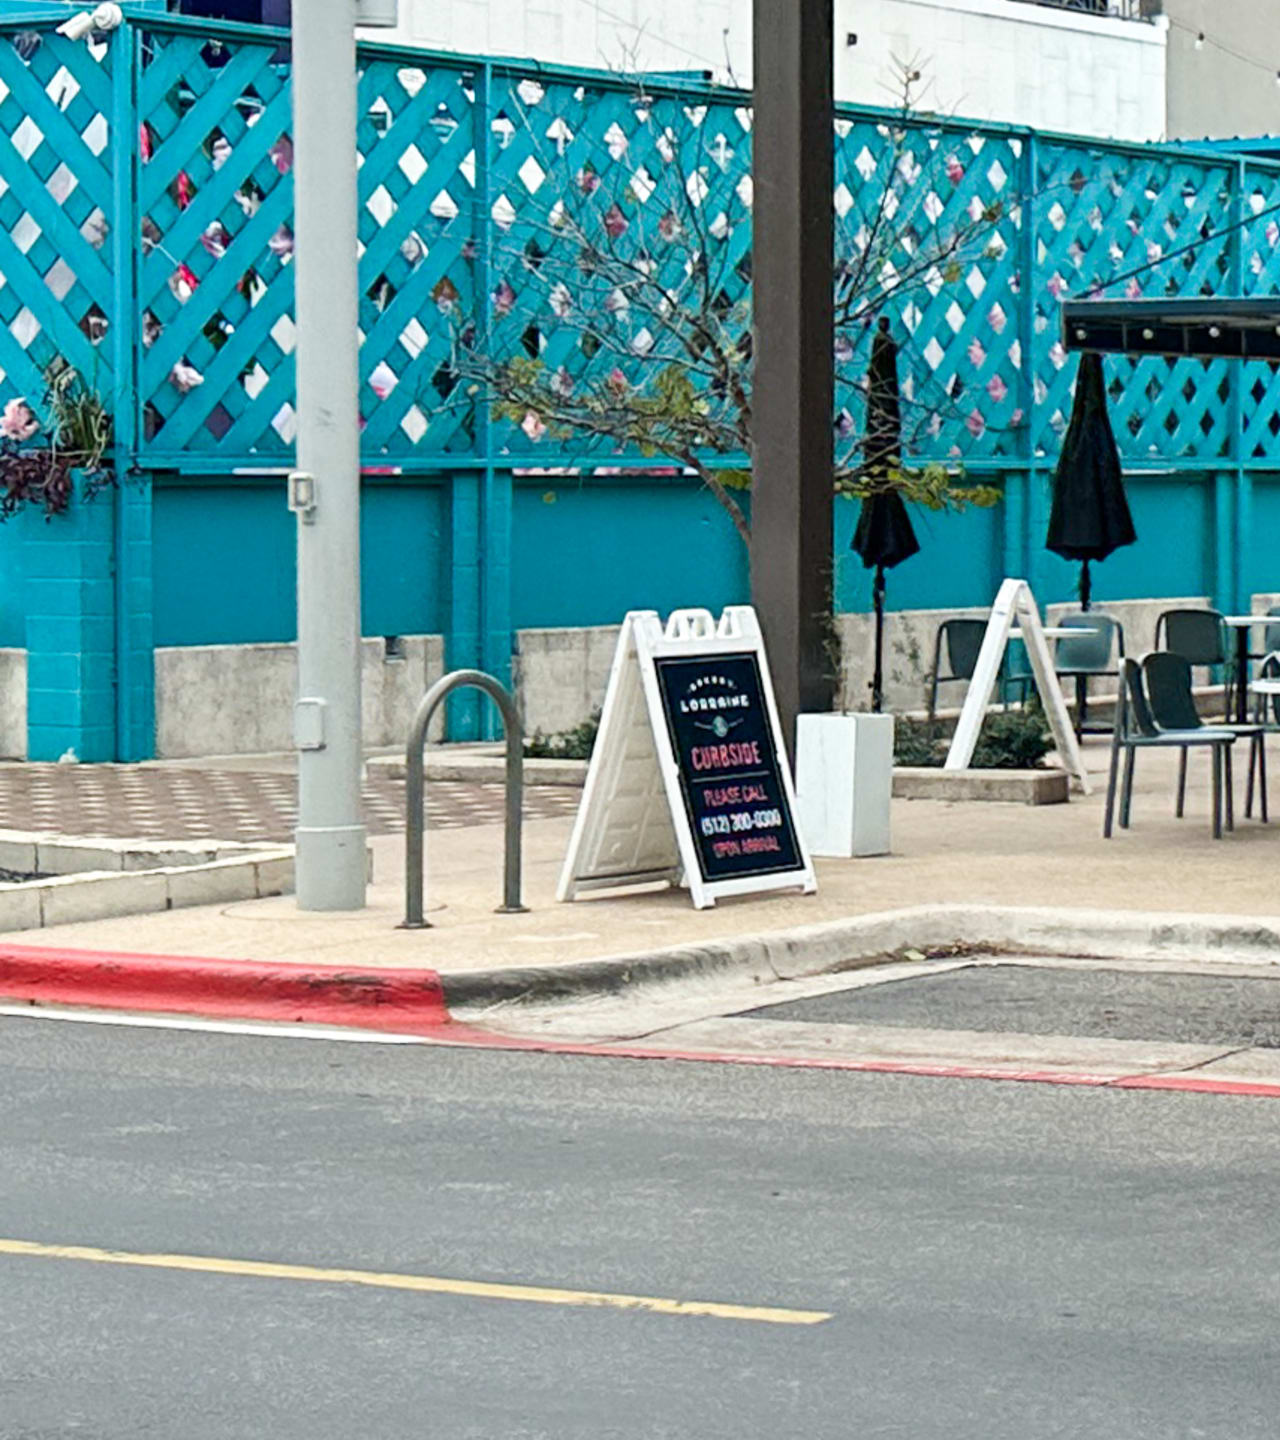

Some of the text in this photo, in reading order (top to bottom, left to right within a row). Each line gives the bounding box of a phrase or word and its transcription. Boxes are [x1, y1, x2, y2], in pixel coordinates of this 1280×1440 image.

[680, 694, 749, 713] LORRAINE
[691, 741, 762, 770] CURBSIDE
[703, 783, 768, 807] PLEASE CALL
